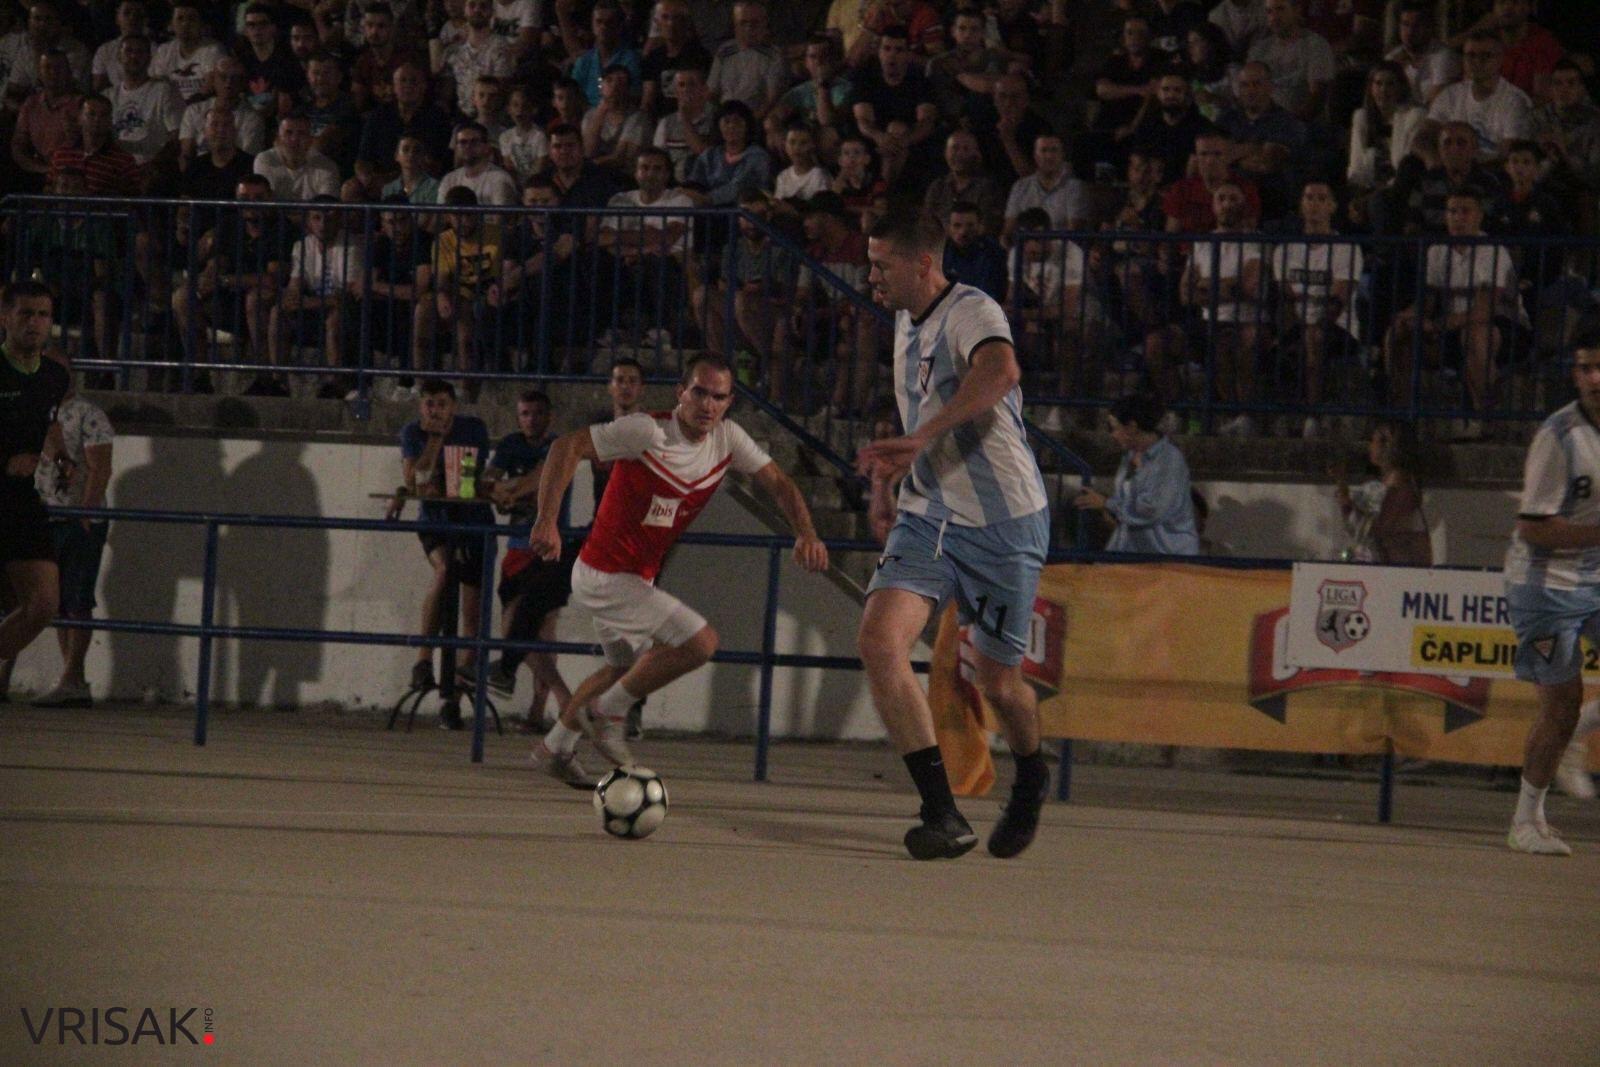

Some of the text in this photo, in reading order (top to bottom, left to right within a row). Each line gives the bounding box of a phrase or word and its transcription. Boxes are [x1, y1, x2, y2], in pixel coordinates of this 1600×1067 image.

[1574, 475, 1592, 500] 8
[651, 503, 673, 517] ibis
[1326, 588, 1357, 602] LIGA
[1402, 591, 1453, 621] MNL
[975, 595, 1007, 638] 11
